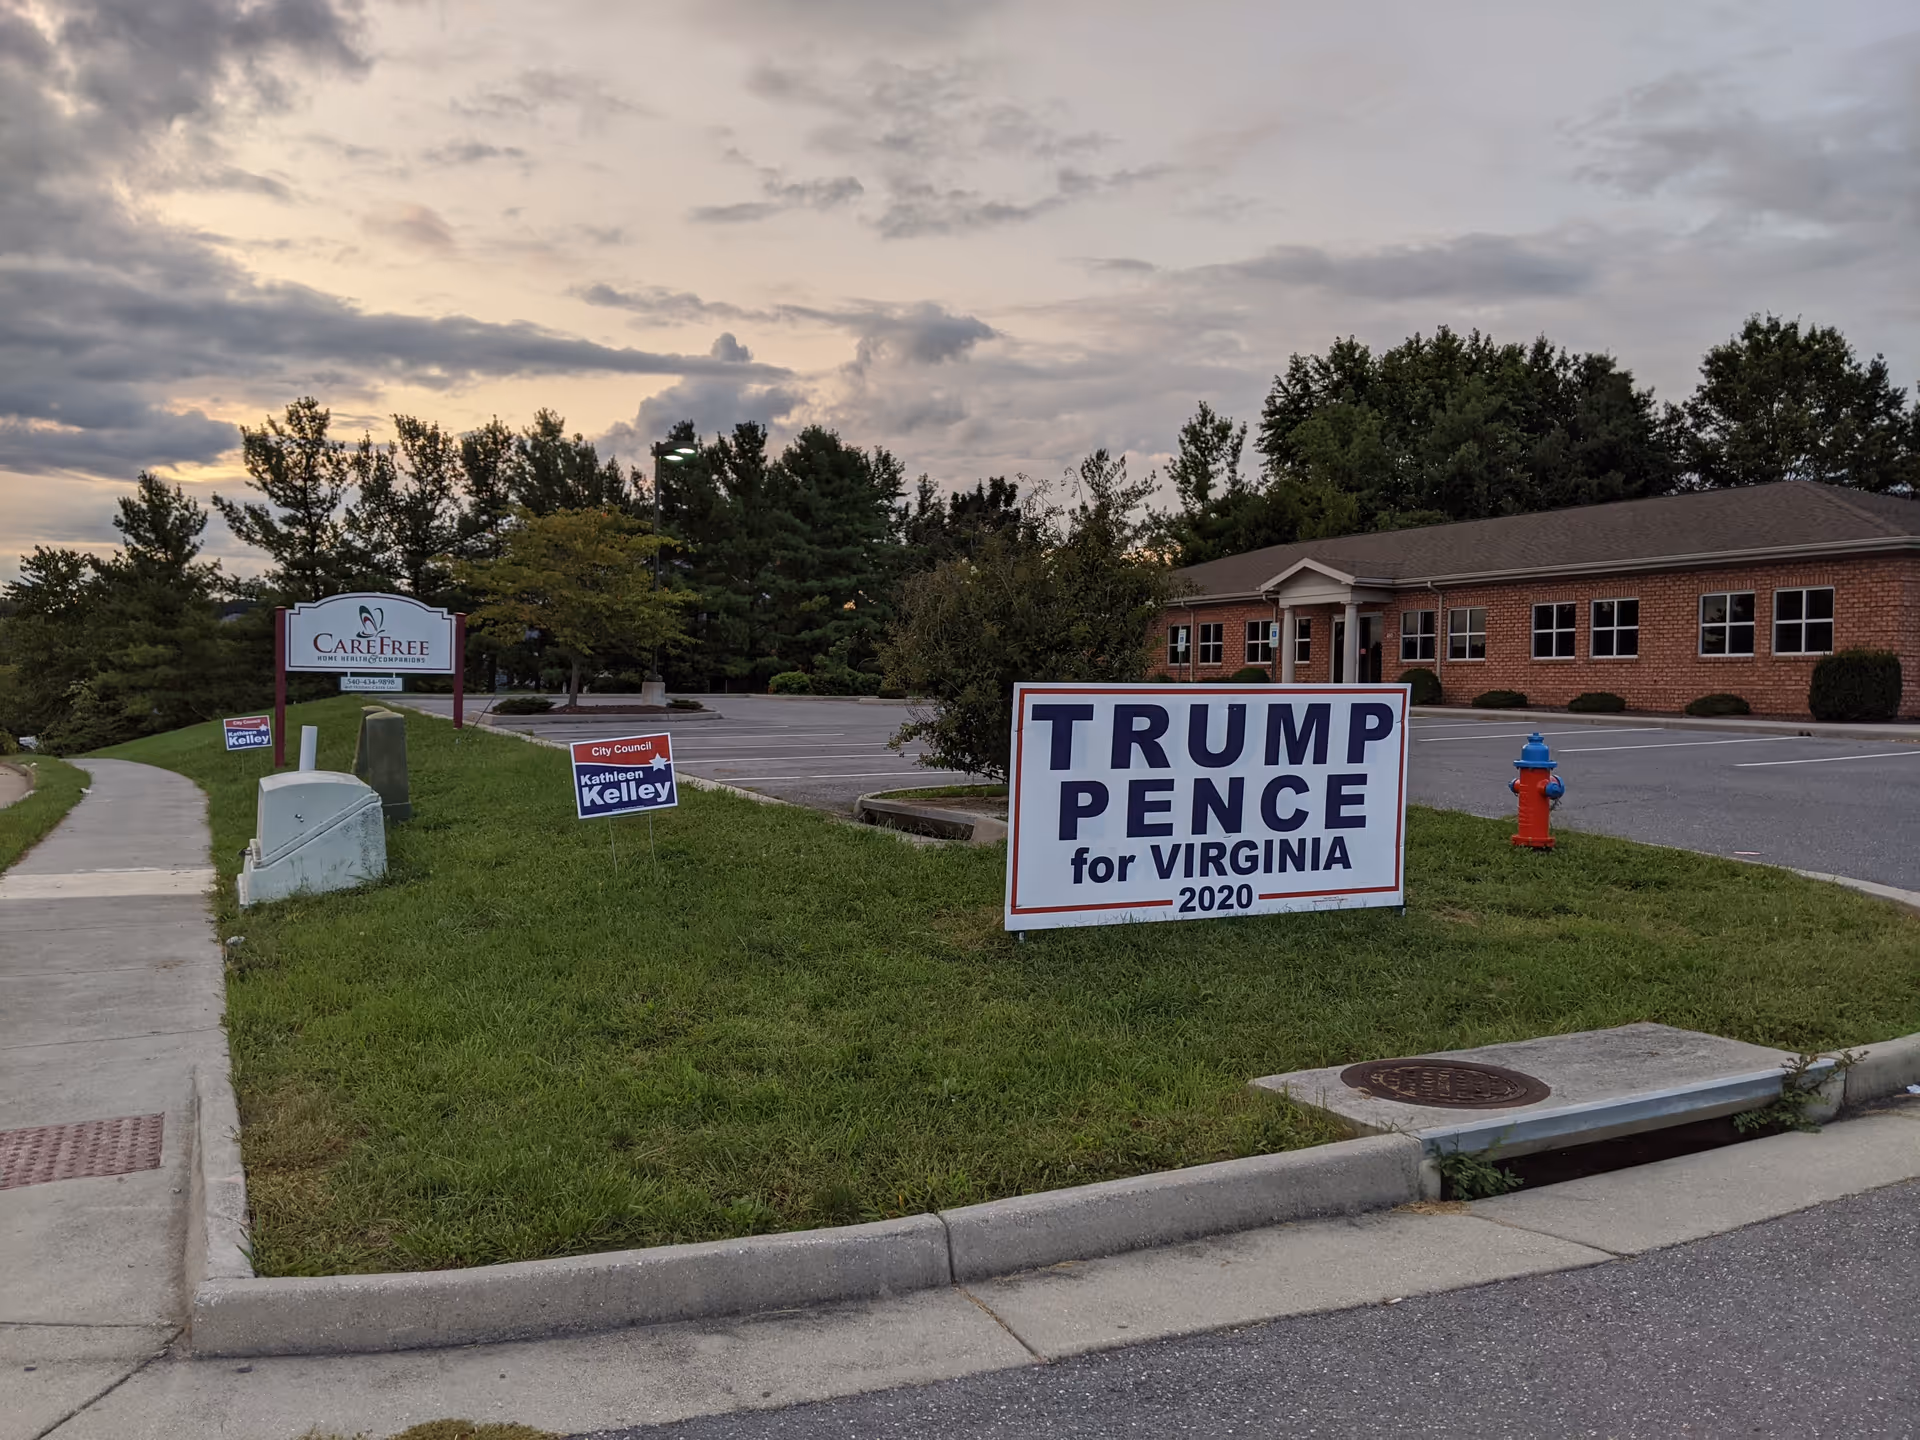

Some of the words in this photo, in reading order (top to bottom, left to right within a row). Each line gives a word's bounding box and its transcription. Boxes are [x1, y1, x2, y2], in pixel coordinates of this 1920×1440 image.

[367, 655, 378, 664] &
[378, 656, 426, 664] COMPANIONS
[229, 735, 269, 746] Kelley
[591, 746, 612, 756] City
[614, 741, 652, 754] Council
[1031, 702, 1394, 771] TRUMP
[580, 770, 644, 786] Kathleen
[581, 780, 672, 807] Kelley
[1058, 773, 1369, 841] PENCE
[1071, 847, 1136, 884] for
[1150, 836, 1352, 880] VIRGINIA
[1178, 883, 1254, 913] 2020
